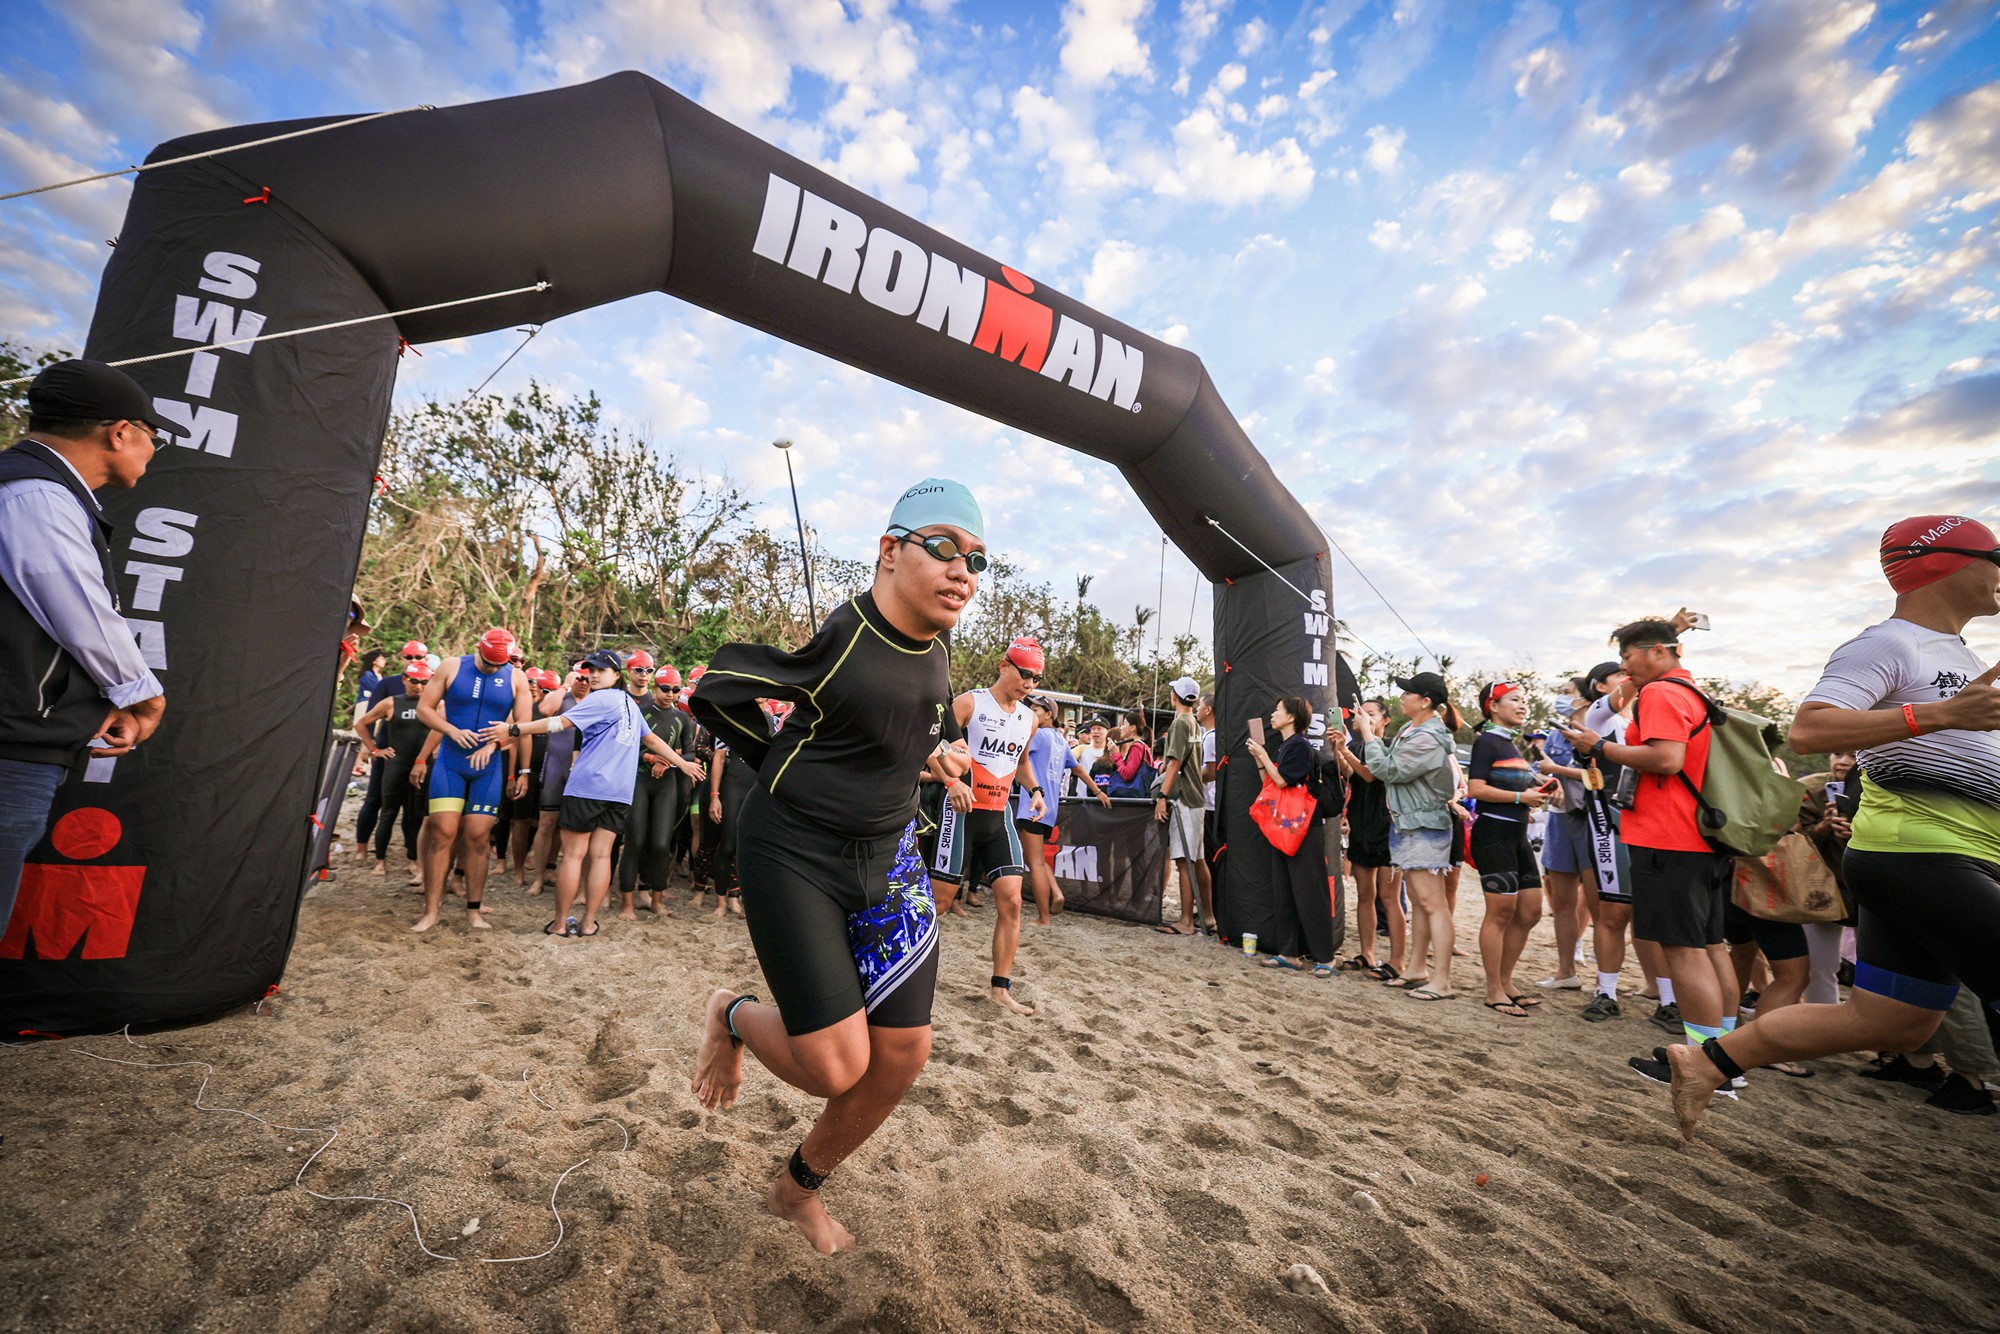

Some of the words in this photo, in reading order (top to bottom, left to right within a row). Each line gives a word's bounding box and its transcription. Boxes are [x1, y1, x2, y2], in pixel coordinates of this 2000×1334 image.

[153, 251, 267, 458] SWIM
[752, 172, 1144, 411] IRONMAN
[1920, 516, 1969, 545] MaiCo
[1303, 589, 1329, 686] SWIM
